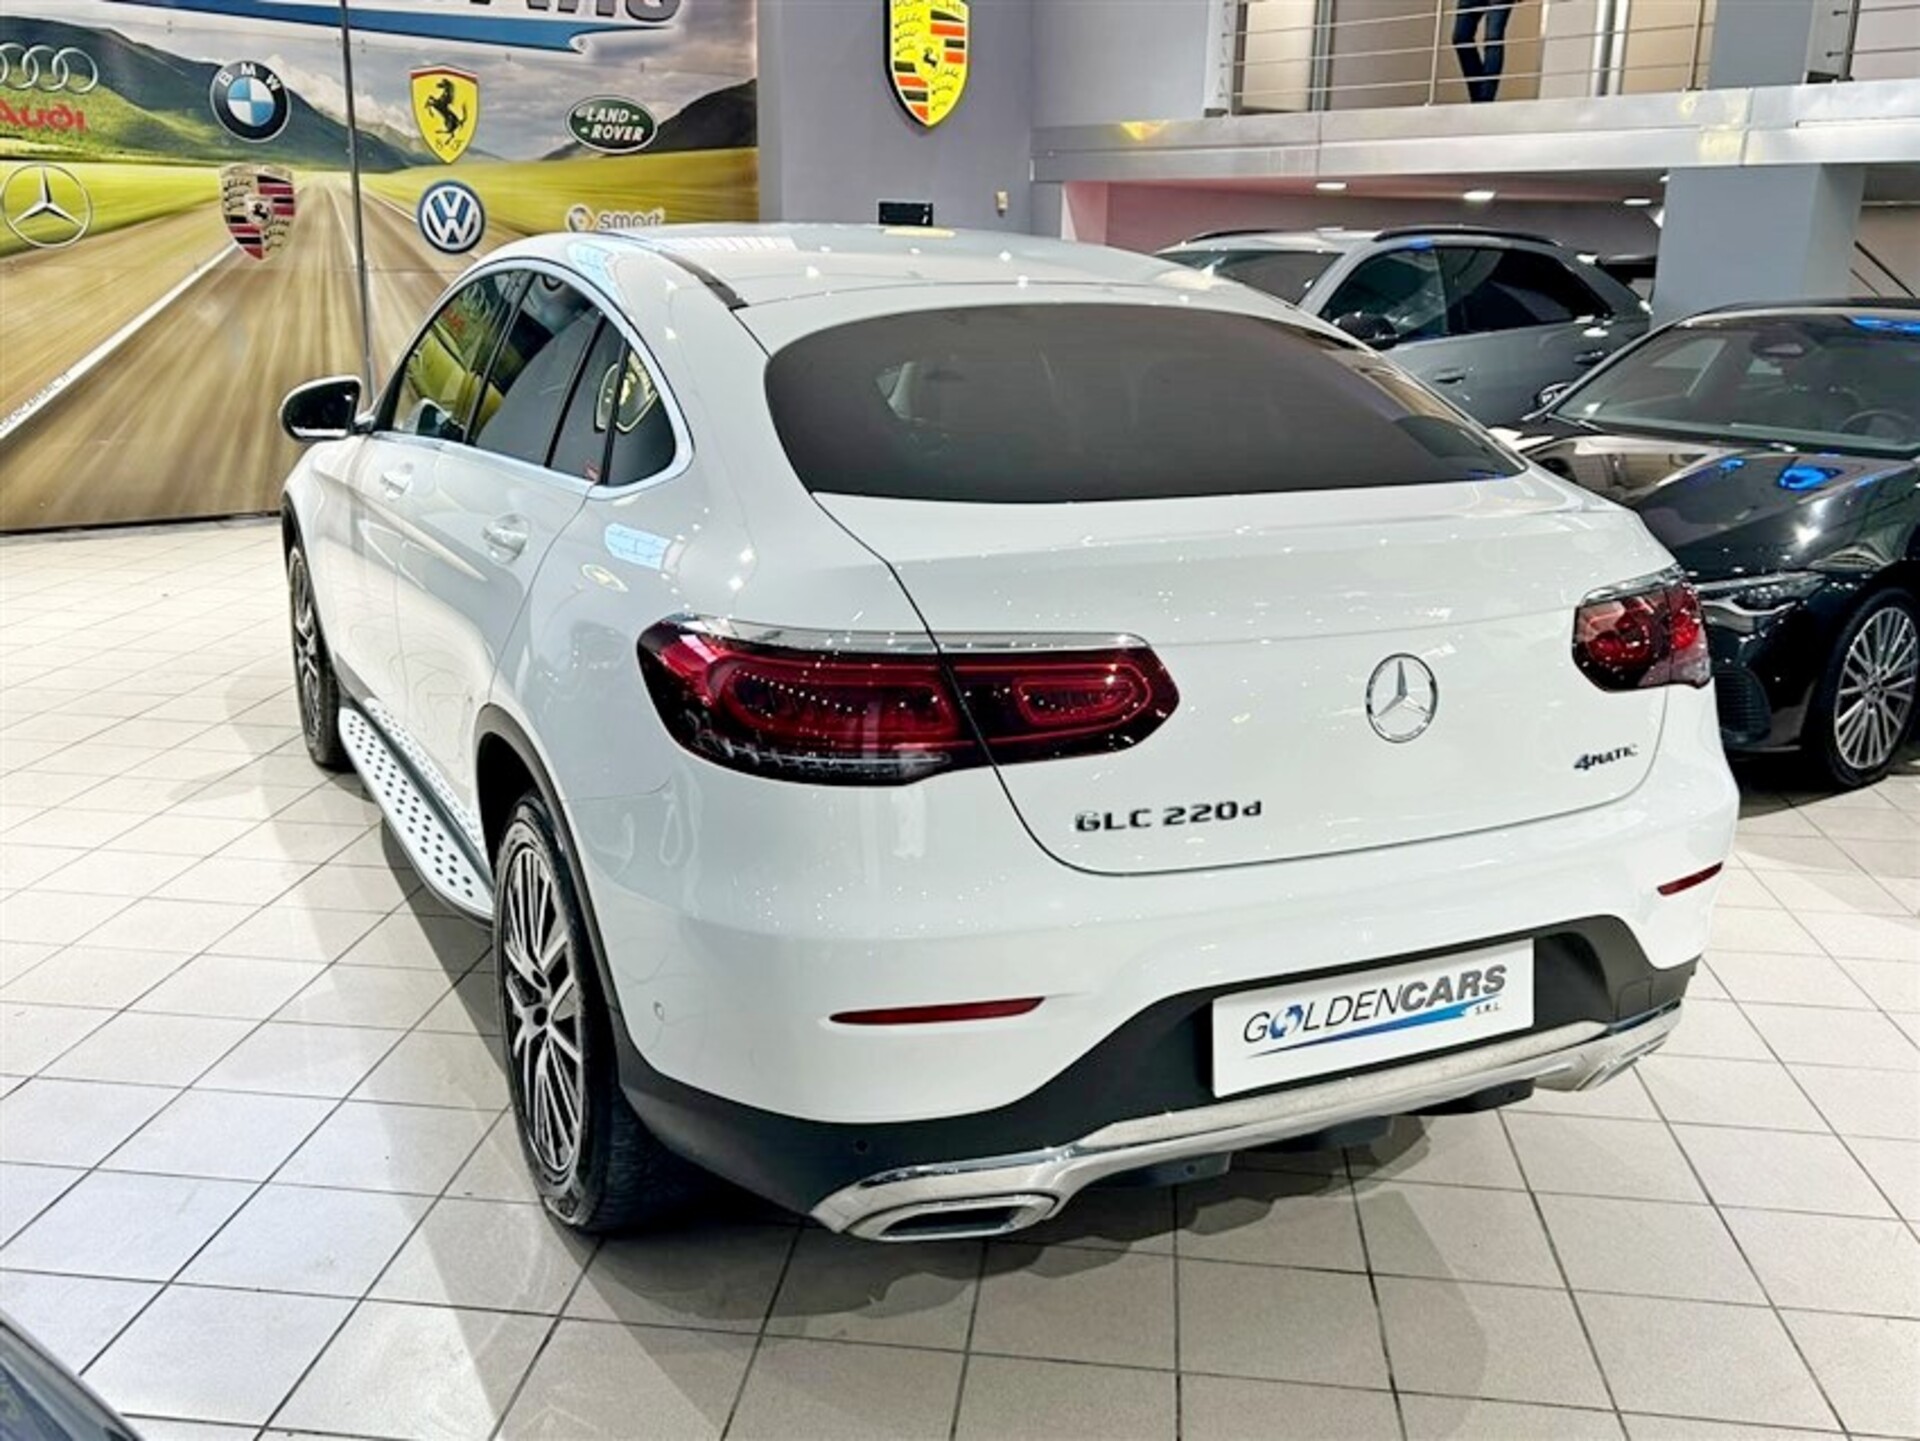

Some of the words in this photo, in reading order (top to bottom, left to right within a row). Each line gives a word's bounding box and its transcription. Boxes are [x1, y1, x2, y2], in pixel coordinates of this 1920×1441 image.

[218, 62, 281, 91] BMW
[586, 107, 630, 122] LAND
[591, 124, 644, 141] ROVER
[599, 209, 662, 230] smart
[1074, 808, 1152, 833] GLC
[1162, 799, 1263, 826] 220d
[1243, 964, 1506, 1043] GOLDENCARS
